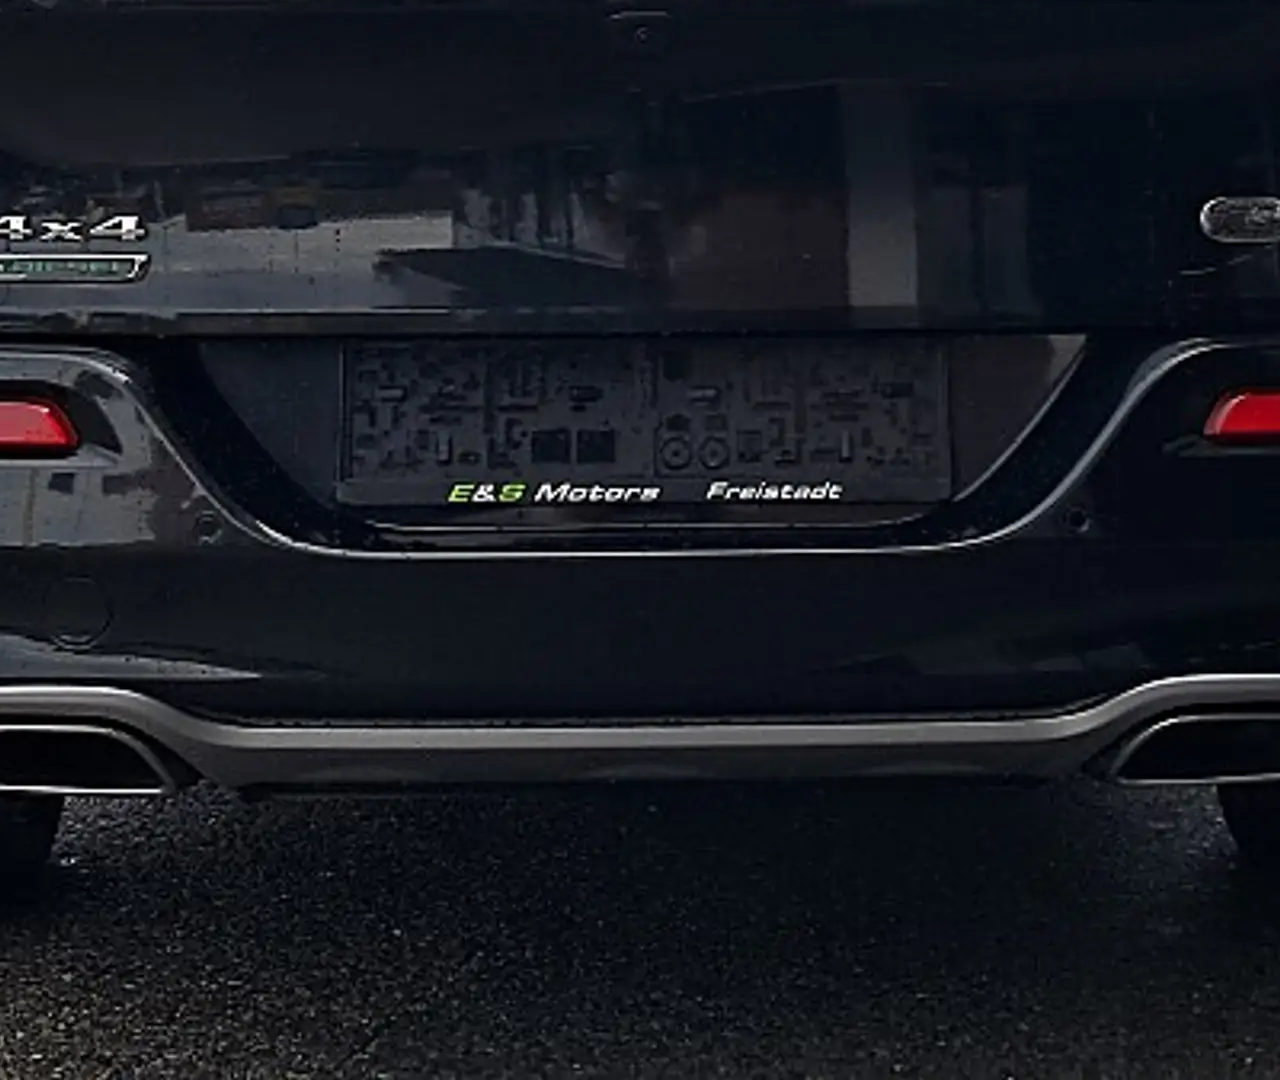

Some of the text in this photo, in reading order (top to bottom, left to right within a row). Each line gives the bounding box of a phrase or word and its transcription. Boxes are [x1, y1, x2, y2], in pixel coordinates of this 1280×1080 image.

[448, 481, 843, 503] E&S Motors Freistadt
